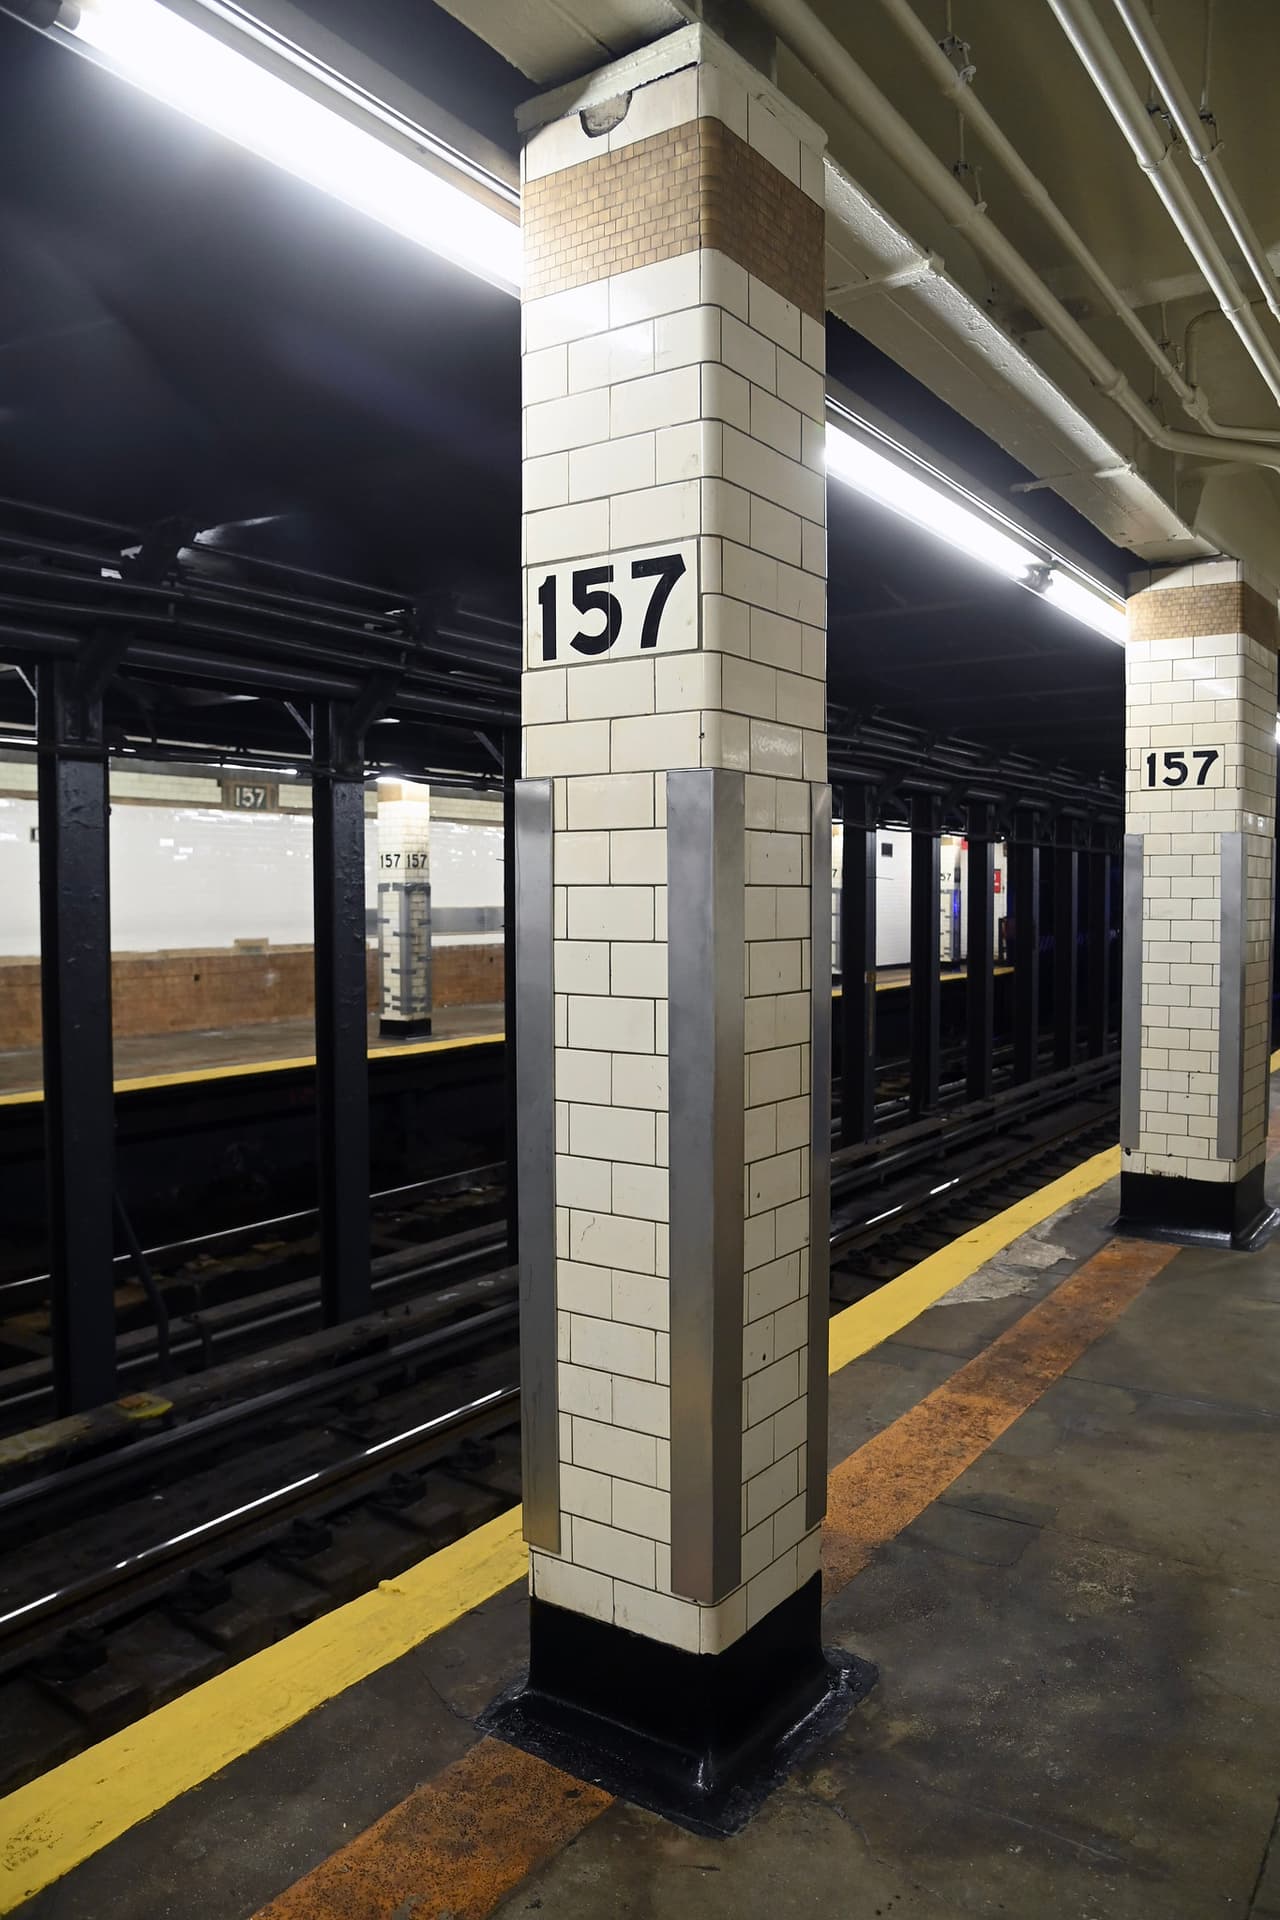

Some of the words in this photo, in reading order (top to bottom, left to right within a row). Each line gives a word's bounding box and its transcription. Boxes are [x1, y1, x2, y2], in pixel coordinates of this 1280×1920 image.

[538, 553, 686, 661] 157
[1147, 750, 1219, 787] 157
[235, 787, 265, 808] 157
[380, 854, 401, 869] 157
[407, 854, 428, 869] 157
[940, 872, 951, 881] 57
